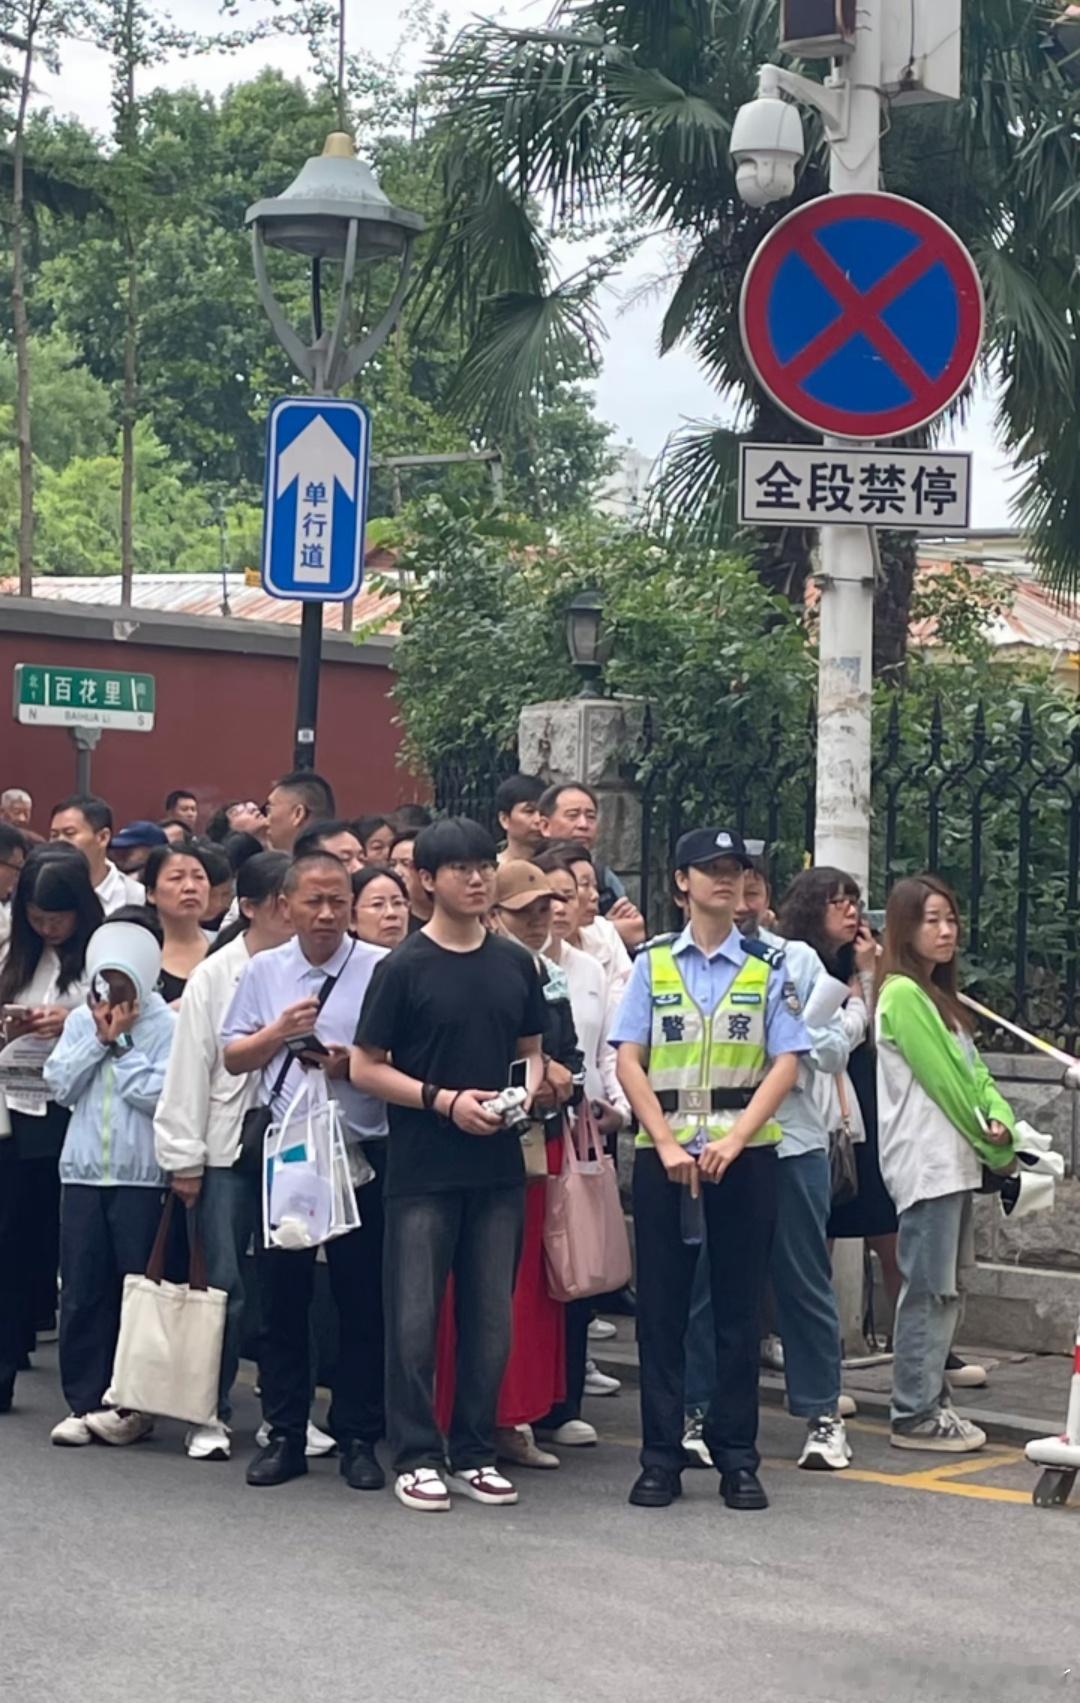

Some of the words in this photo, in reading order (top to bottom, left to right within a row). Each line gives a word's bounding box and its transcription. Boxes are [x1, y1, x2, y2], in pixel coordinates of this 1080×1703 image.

[756, 460, 957, 516] 全段禁停
[300, 482, 328, 568] 单行道
[55, 677, 121, 705] 百花里
[29, 709, 37, 721] N
[137, 715, 145, 726] S
